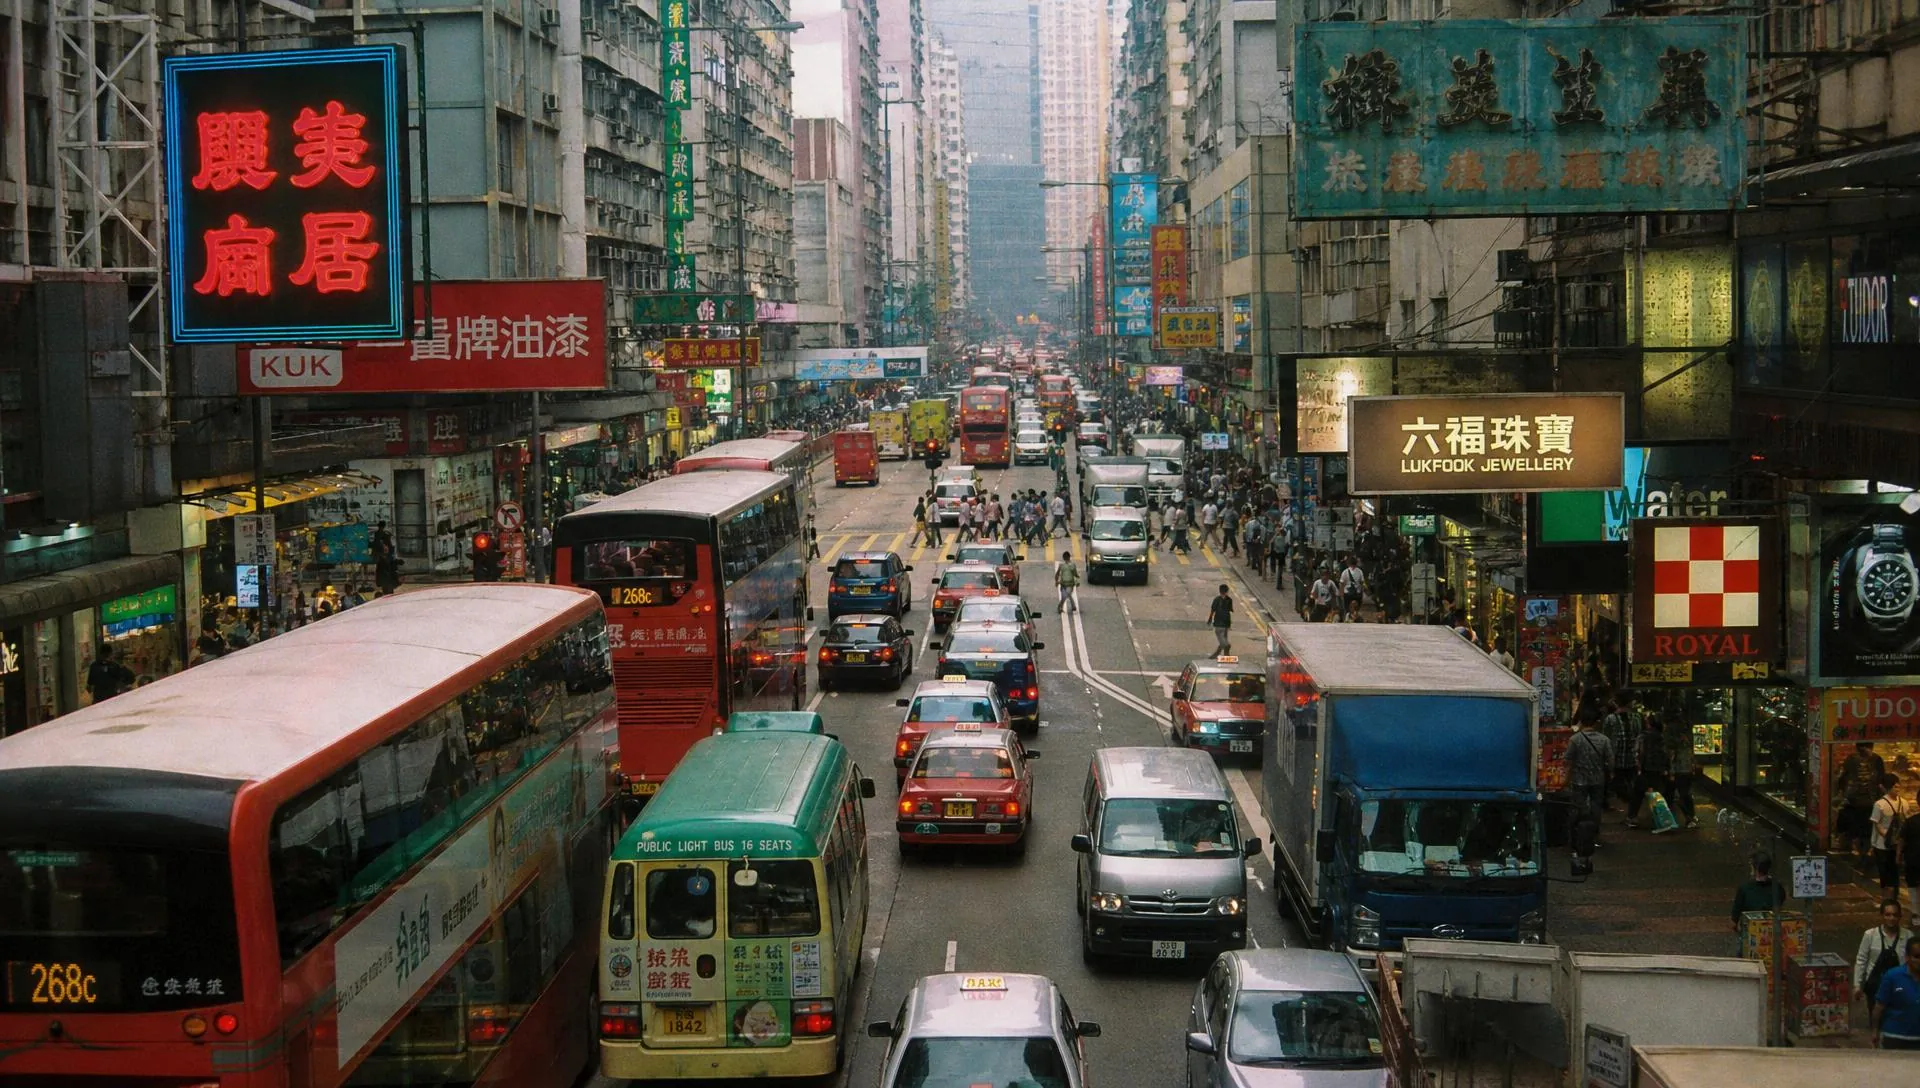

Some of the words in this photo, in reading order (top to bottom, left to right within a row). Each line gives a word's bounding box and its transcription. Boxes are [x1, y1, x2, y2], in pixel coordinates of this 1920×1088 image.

[261, 355, 332, 377] KUK
[1401, 414, 1575, 455] 六福珠寶
[1401, 459, 1475, 473] LUKFOOK
[1481, 458, 1574, 472] JEWELLERY
[1607, 482, 1727, 520] Water
[1654, 634, 1760, 656] ROYAL
[1832, 697, 1920, 719] TUDO
[636, 841, 671, 853] PUBLIC
[678, 840, 708, 852] LIGHT
[714, 840, 734, 851] BUS
[742, 839, 753, 850] 16
[759, 839, 792, 850] SEATS
[31, 963, 97, 1003] 268c
[669, 1019, 703, 1033] 1842
